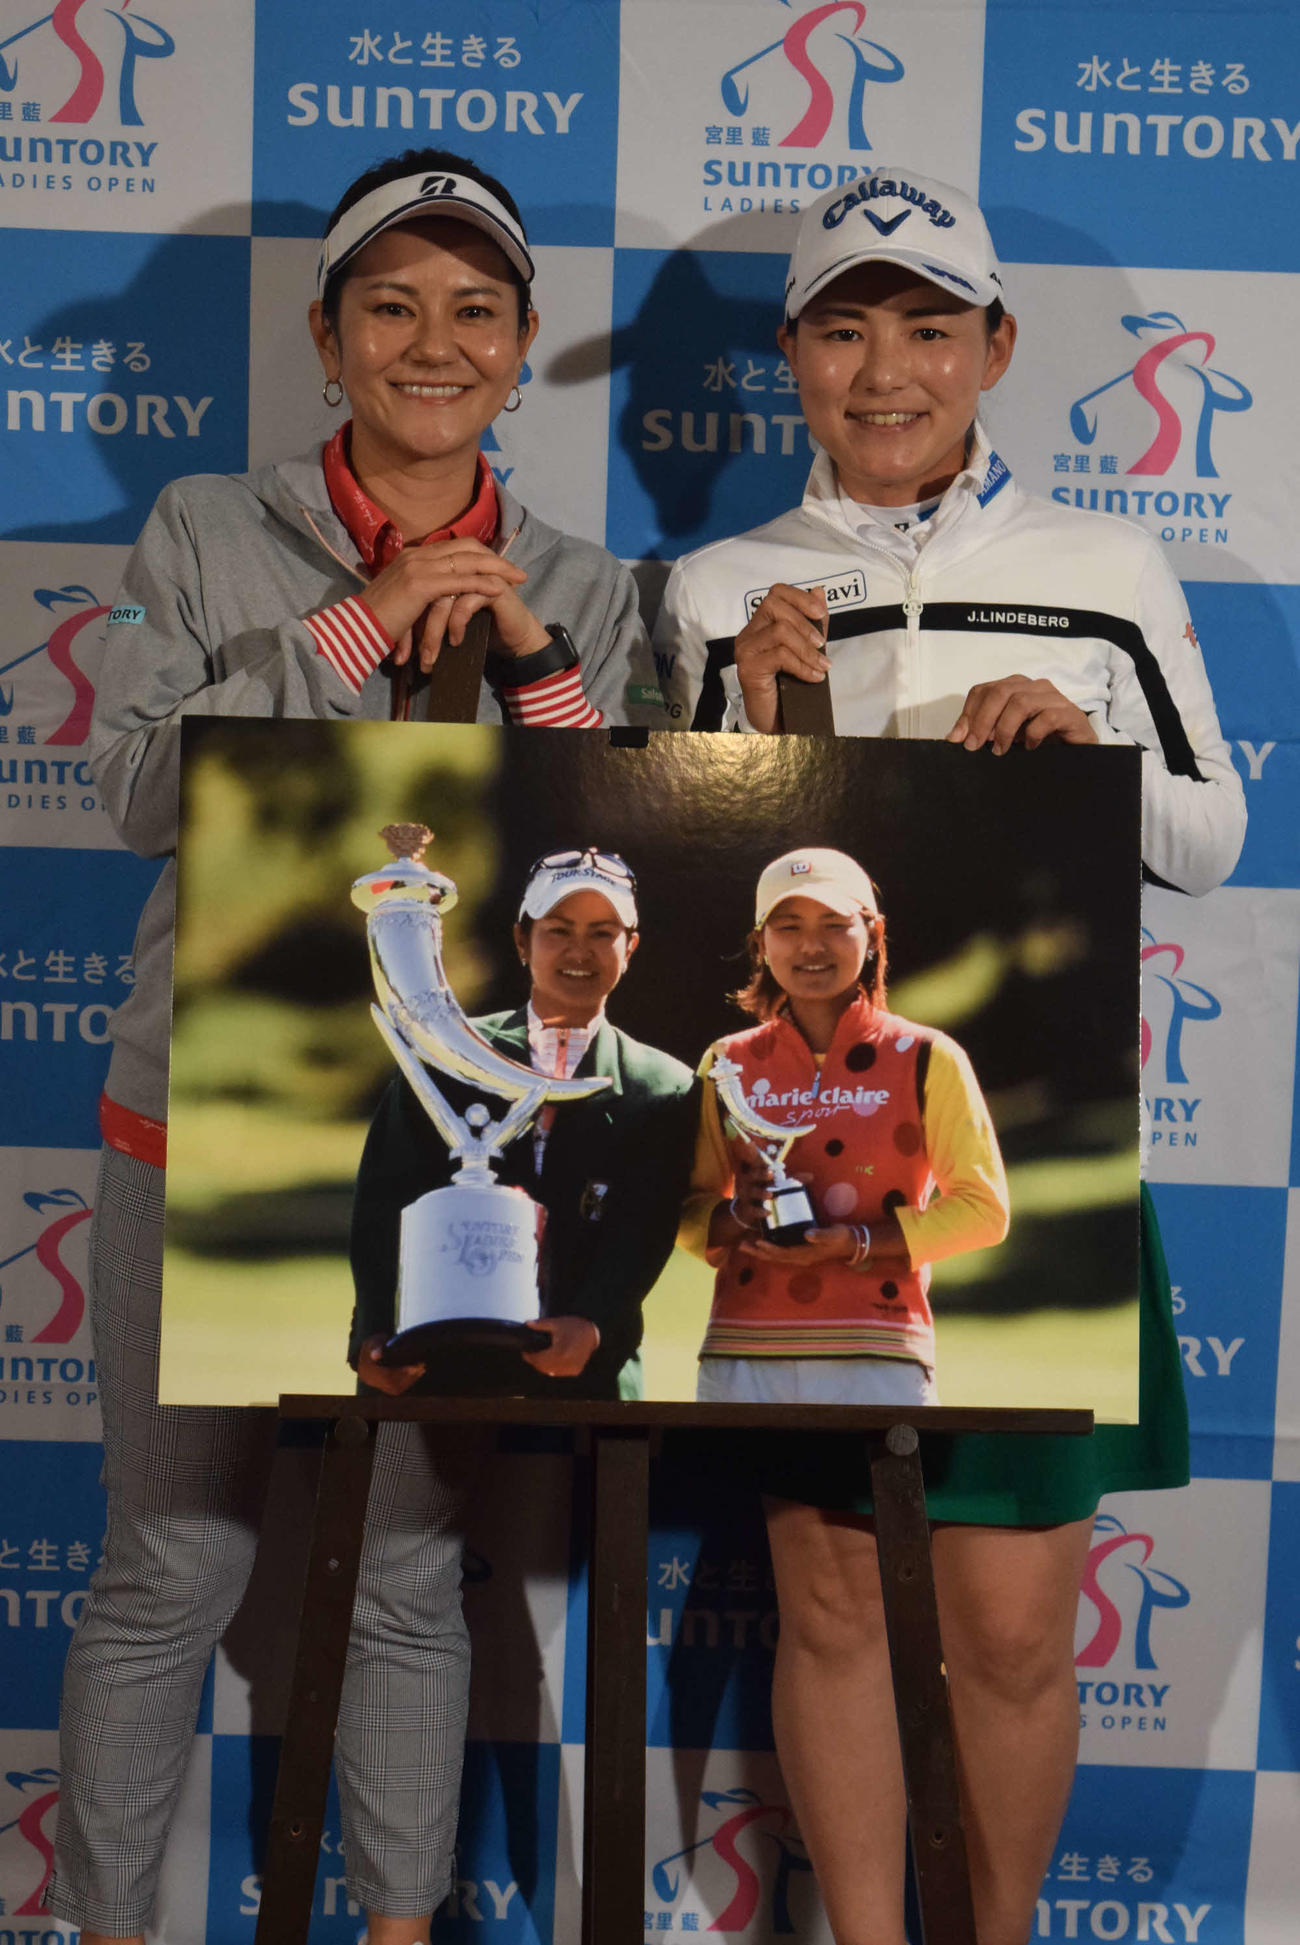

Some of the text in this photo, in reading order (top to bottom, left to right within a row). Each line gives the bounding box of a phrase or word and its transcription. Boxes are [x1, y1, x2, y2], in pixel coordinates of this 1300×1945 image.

[349, 29, 521, 68] 水と生きる
[1076, 55, 1250, 95] 水と生きる
[287, 82, 584, 135] SUNTORY
[87, 176, 156, 193] OPEN
[703, 196, 800, 214] LADIES
[822, 177, 956, 230] Callaway
[1160, 527, 1229, 544] OPEN
[967, 611, 1070, 628] J.LINDEBERG
[746, 1086, 890, 1108] marie claire
[1101, 1715, 1167, 1731] OPEN
